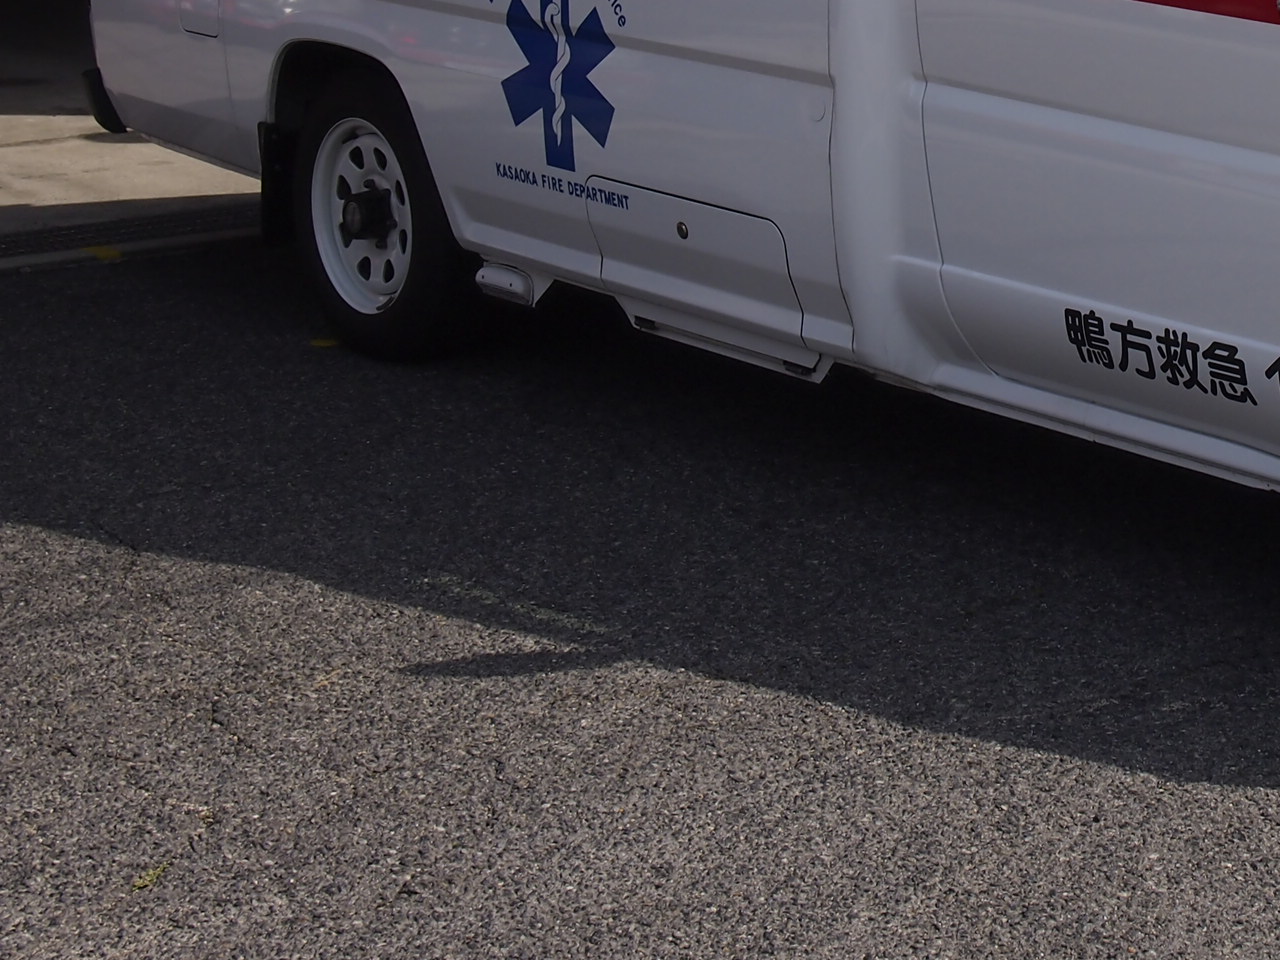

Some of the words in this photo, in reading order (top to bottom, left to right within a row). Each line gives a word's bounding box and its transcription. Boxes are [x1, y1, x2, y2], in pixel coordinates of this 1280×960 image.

[495, 162, 538, 187] KASAOKA
[541, 174, 563, 193] FIRE
[568, 181, 630, 210] DEPARTMENT
